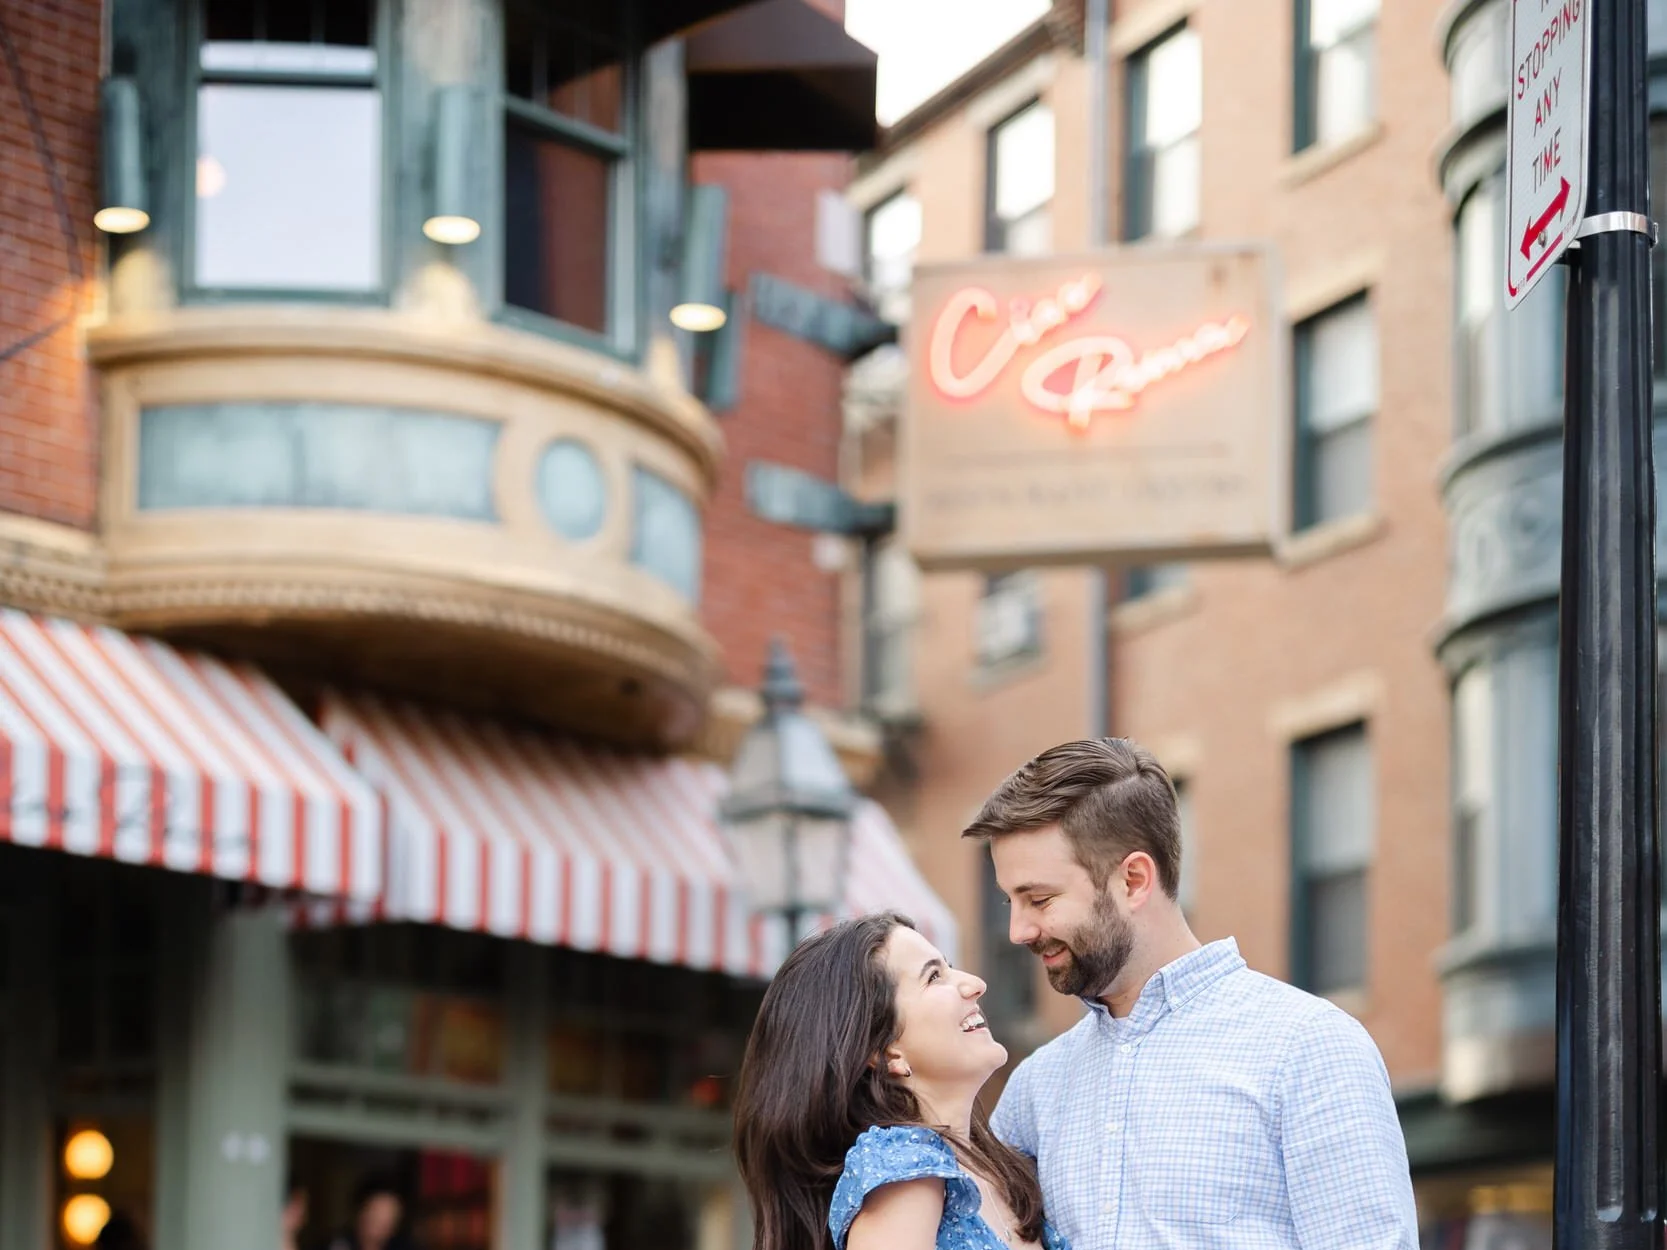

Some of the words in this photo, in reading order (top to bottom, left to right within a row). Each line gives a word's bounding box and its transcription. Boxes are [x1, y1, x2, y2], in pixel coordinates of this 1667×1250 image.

[1517, 0, 1580, 100] STOPPING
[1533, 66, 1562, 137] ANY
[1532, 126, 1561, 194] TIME
